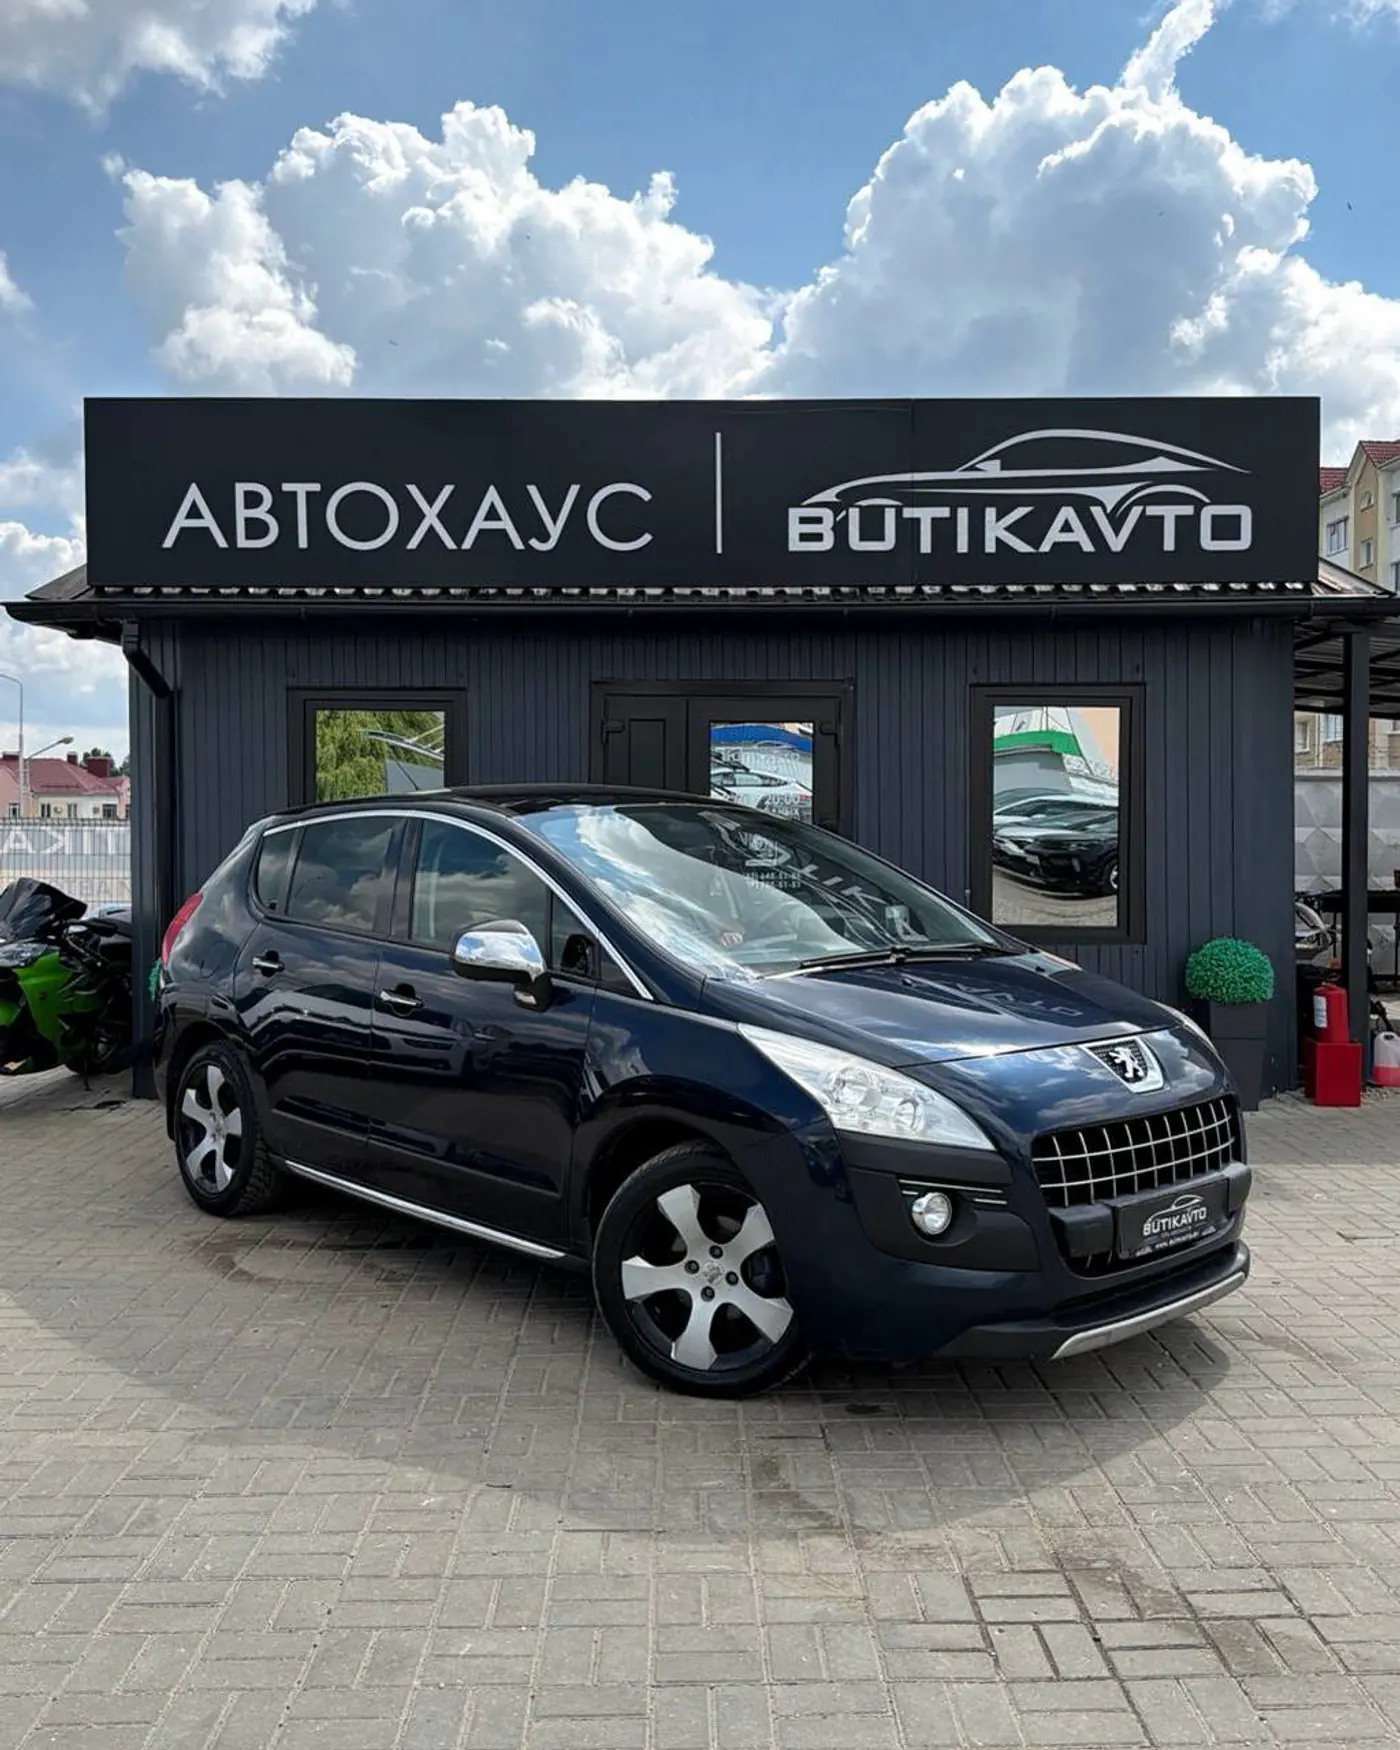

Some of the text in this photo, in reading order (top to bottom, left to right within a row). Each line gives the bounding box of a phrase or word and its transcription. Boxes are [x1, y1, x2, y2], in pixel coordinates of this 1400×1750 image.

[161, 481, 653, 552] АВТОХАУС
[787, 505, 1254, 554] BUTIKAVTO
[1143, 1207, 1207, 1236] BUTIKAVTO
